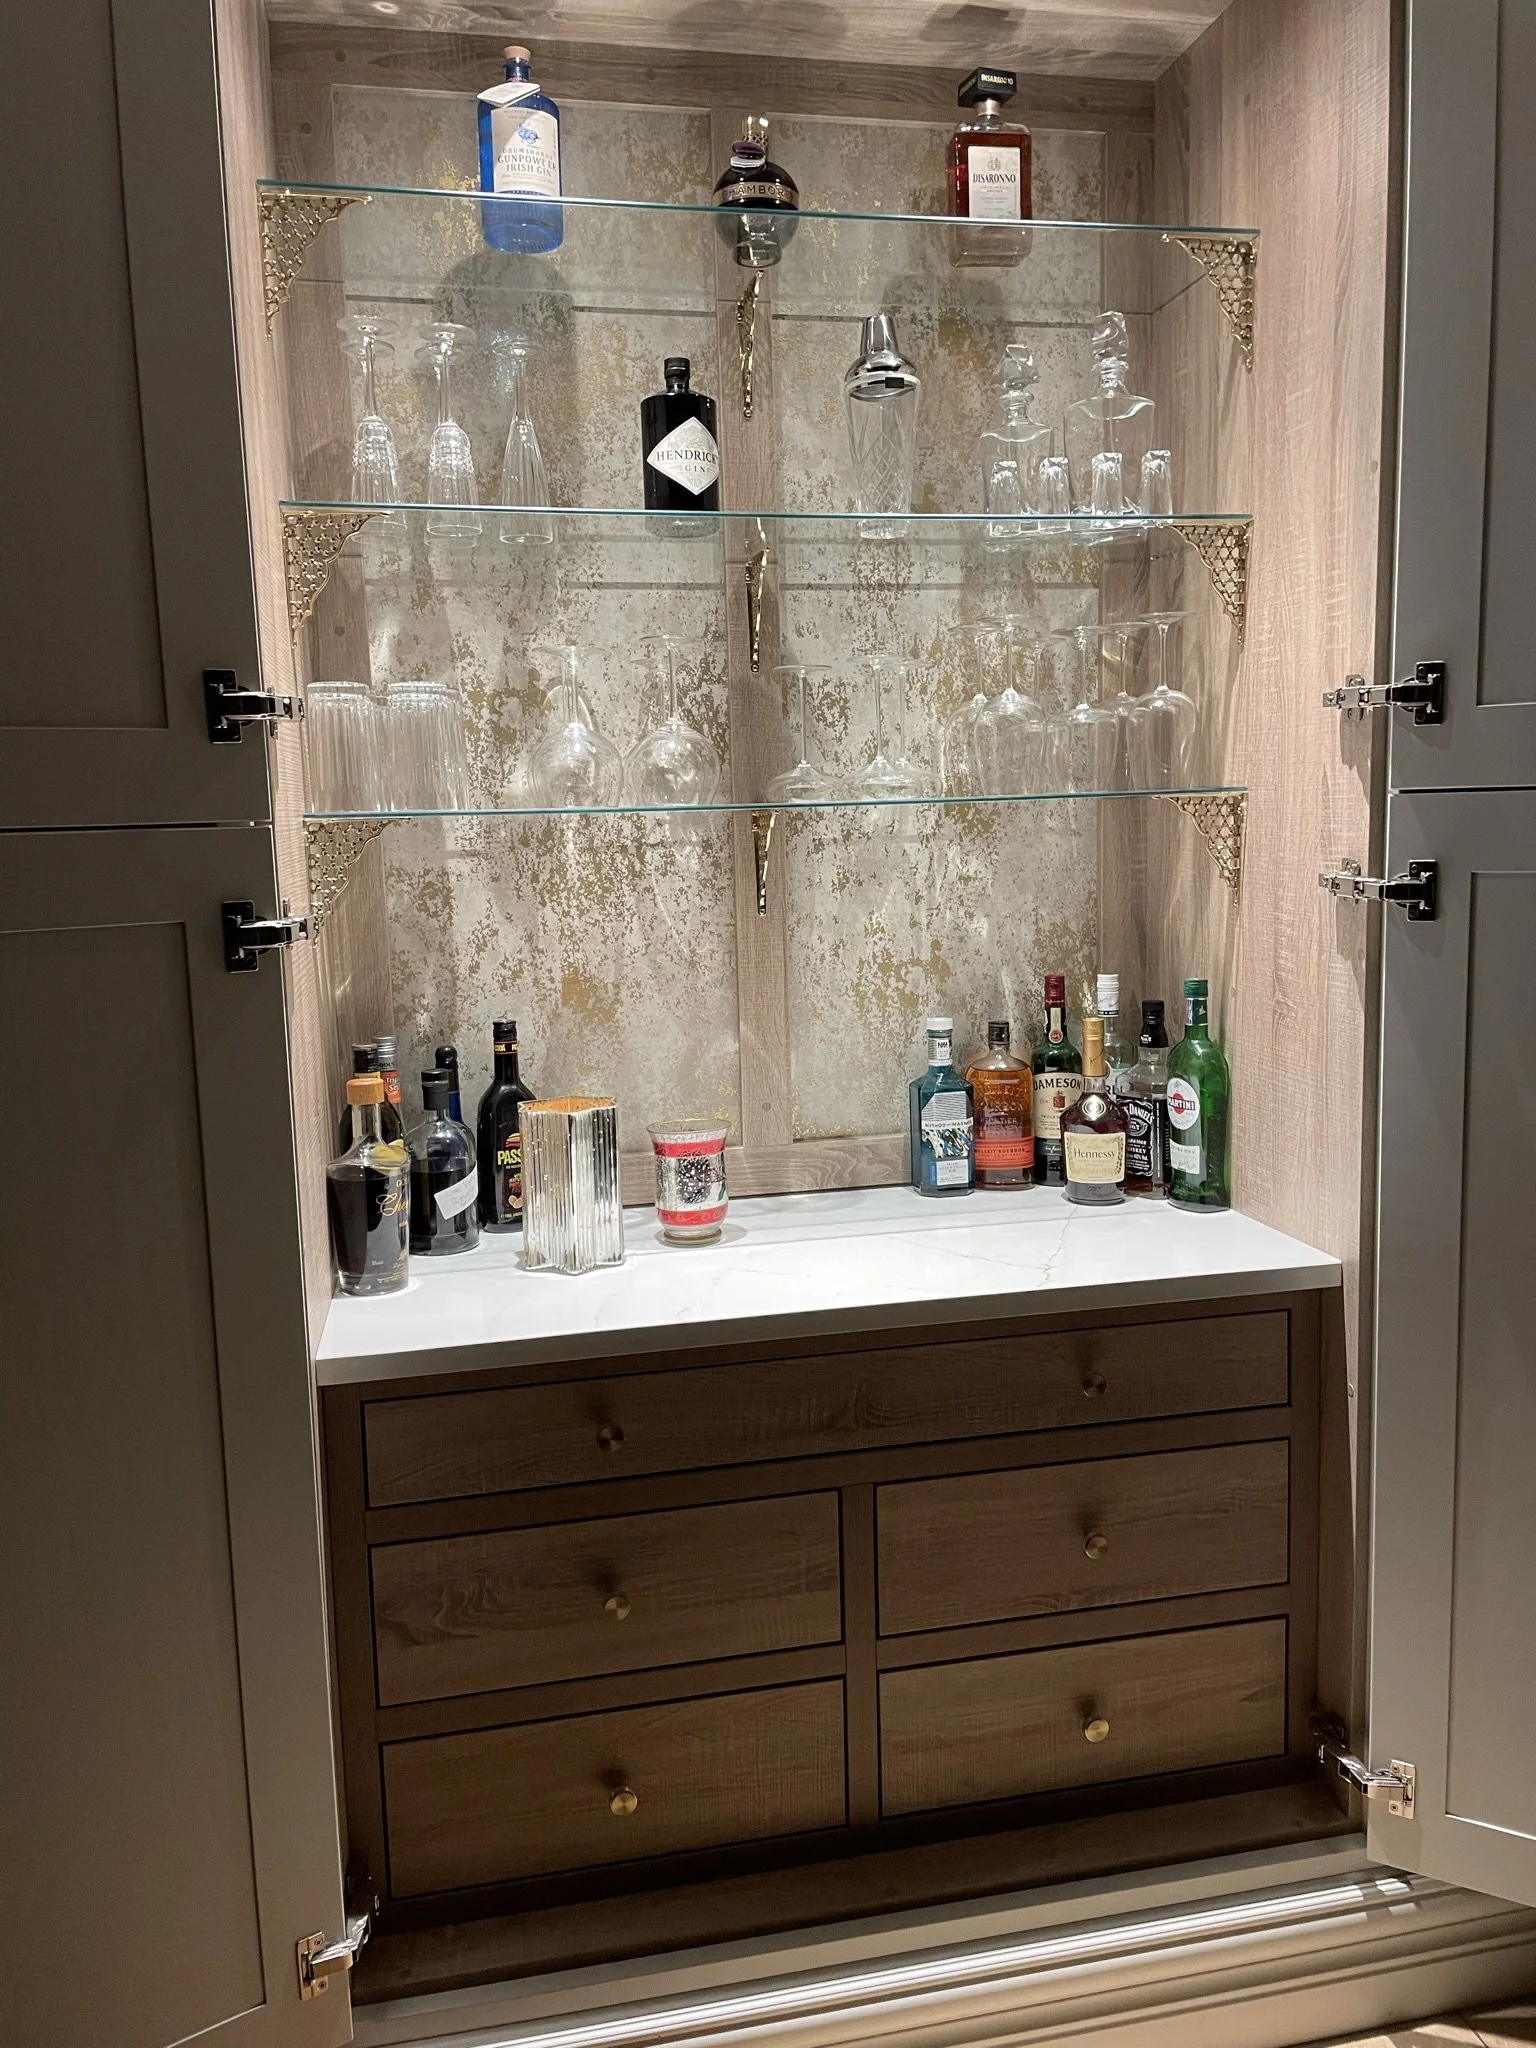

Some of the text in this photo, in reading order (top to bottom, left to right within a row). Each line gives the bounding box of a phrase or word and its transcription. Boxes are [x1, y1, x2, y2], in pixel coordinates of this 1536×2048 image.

[506, 163, 552, 177] IRISH GIN
[972, 173, 1016, 184] DISARONNO
[684, 465, 706, 473] GIN
[1033, 1078, 1081, 1092] JAMESON
[1167, 1097, 1195, 1110] MARTINI
[1128, 1103, 1155, 1125] DANIEL'S
[497, 1148, 521, 1166] PASS
[1073, 1147, 1115, 1159] Hennessy
